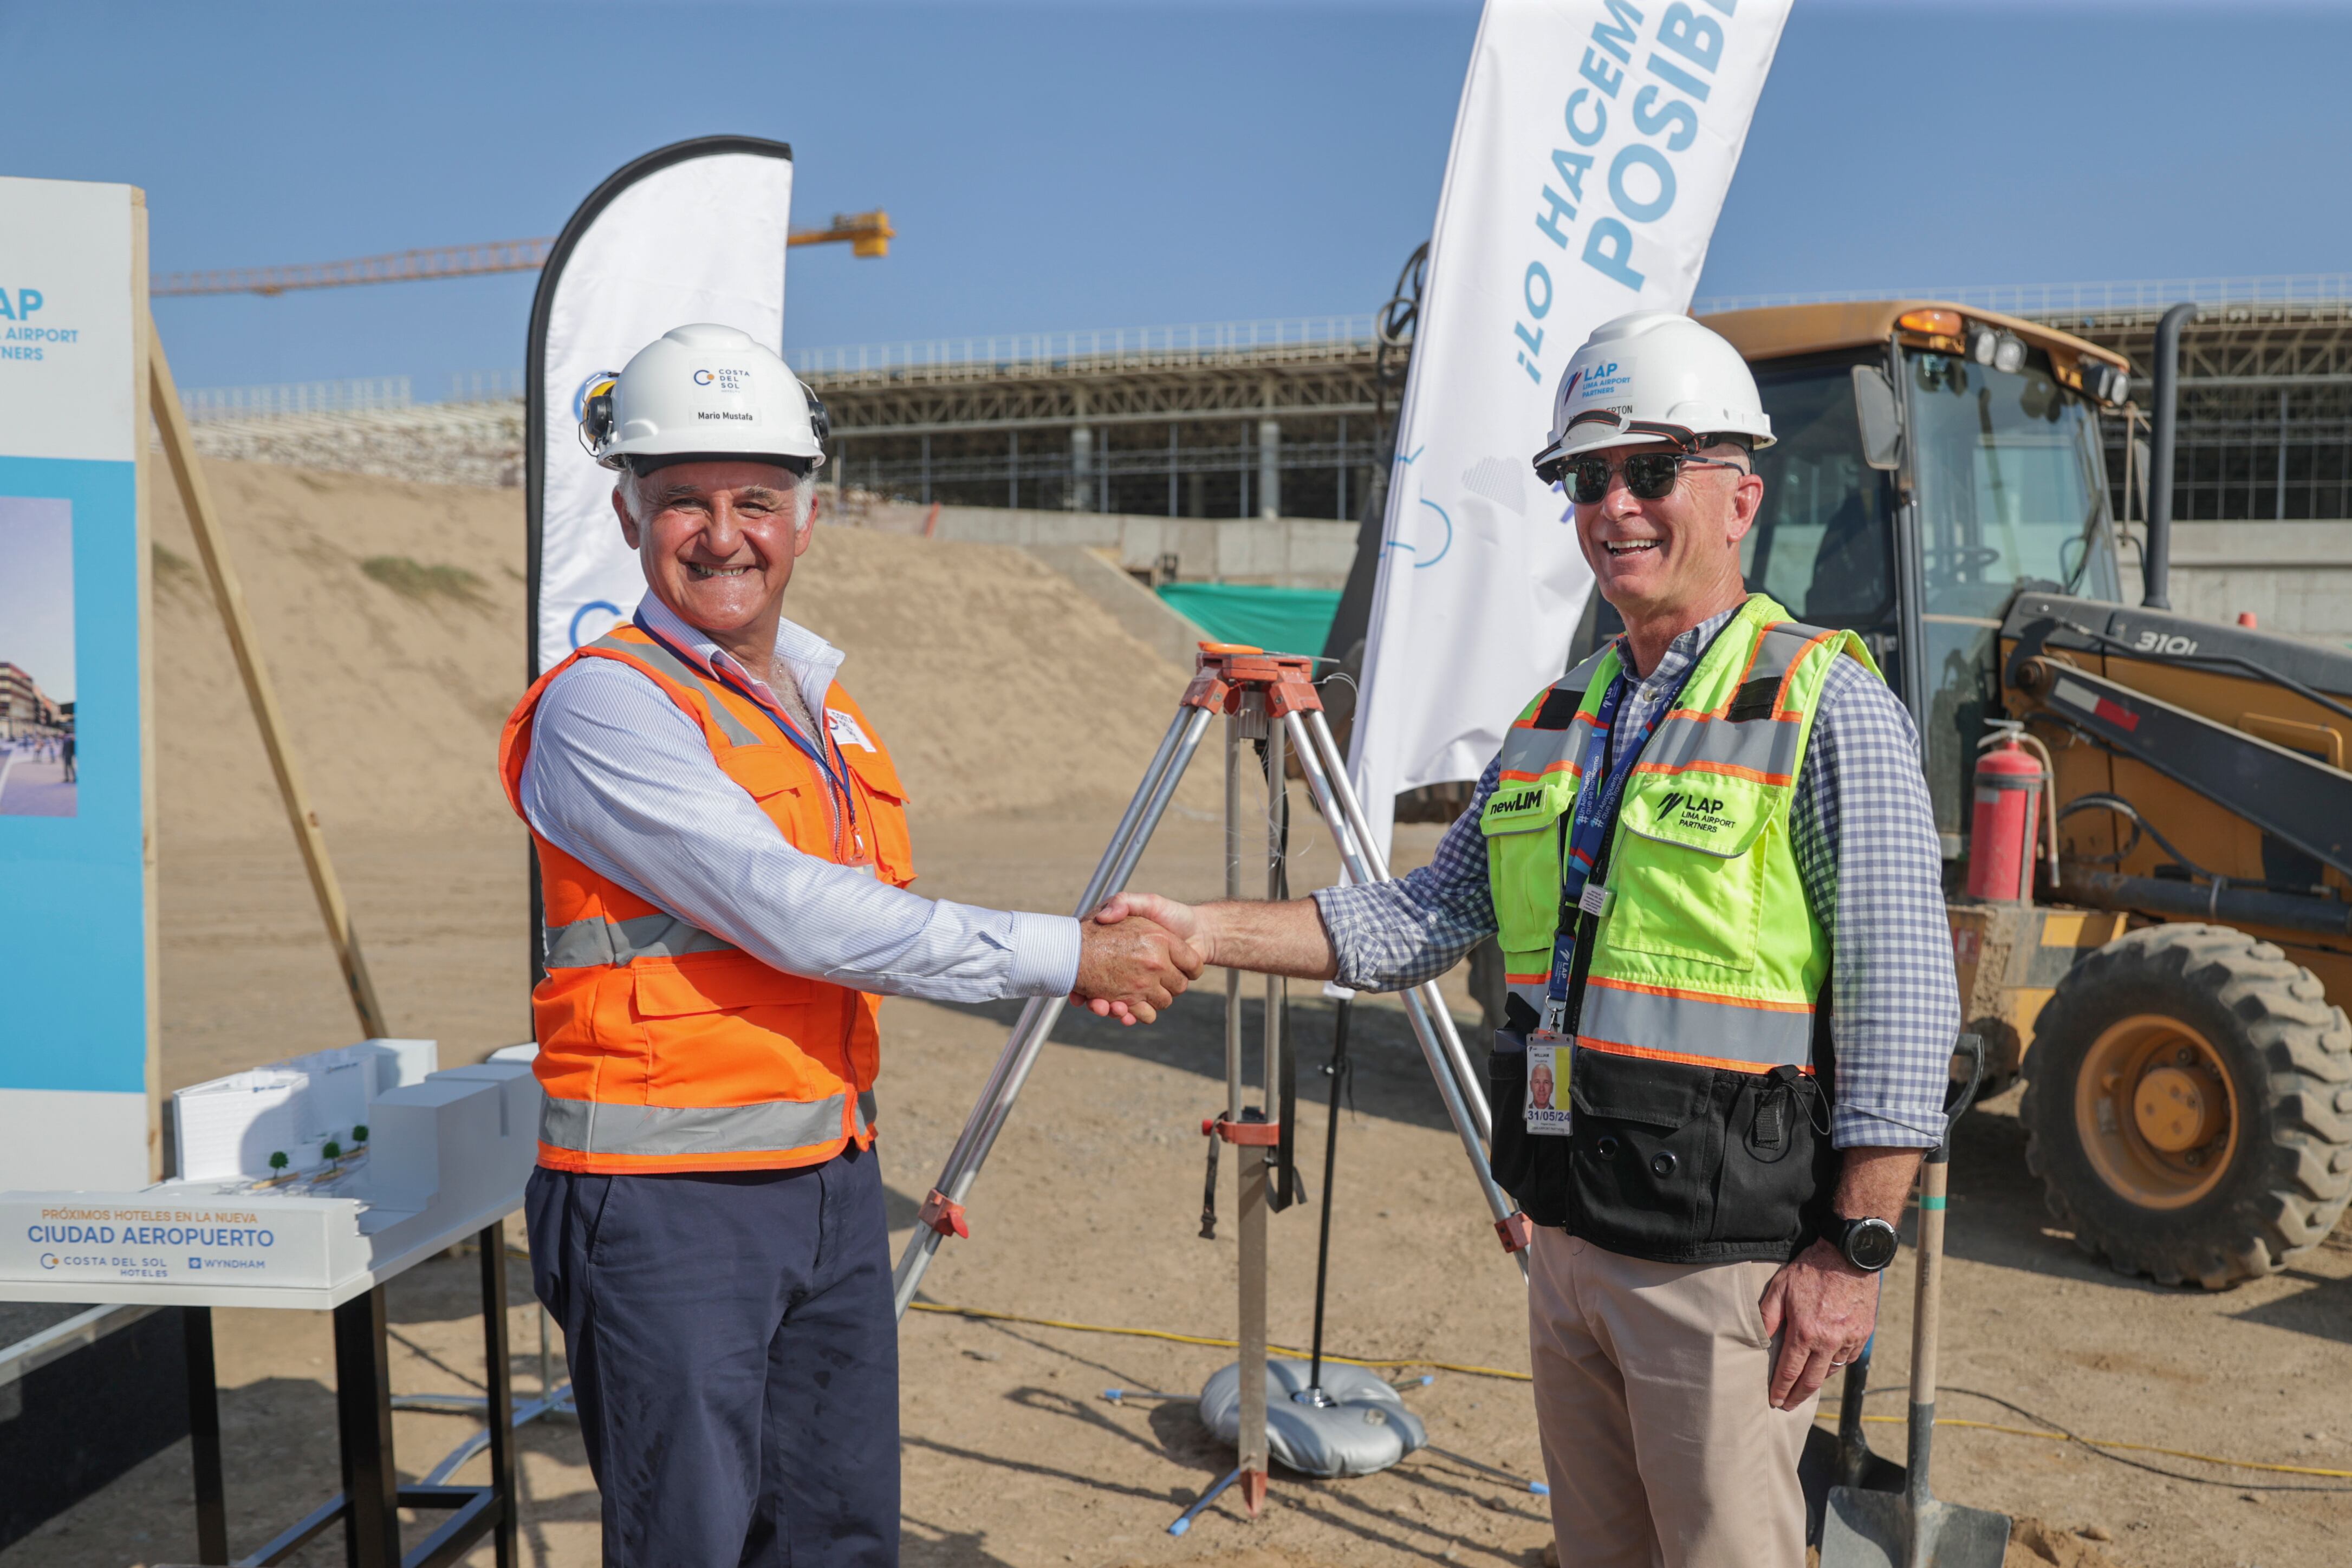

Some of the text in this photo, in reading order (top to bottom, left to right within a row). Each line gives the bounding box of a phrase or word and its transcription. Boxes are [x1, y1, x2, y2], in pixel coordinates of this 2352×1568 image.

[1581, 0, 1737, 292] POSIB
[5, 327, 79, 343] AIRPORT
[719, 369, 750, 377] COSTA
[1584, 362, 1617, 382] LAP
[1582, 377, 1630, 390] LIMA AIRPORT
[1582, 387, 1615, 399] PARTNERS
[698, 412, 753, 421] Mario Mustafa
[1490, 790, 1543, 815] newLIM
[1685, 794, 1724, 815] LAP
[1679, 819, 1718, 833] PARTNERS
[1681, 811, 1736, 829] LIMA AIRPORT
[1528, 1110, 1571, 1122] 31/05/24
[42, 1207, 258, 1224] PRÓXIMOS HOTELES EN LA NUEVA
[28, 1225, 274, 1247] CIUDAD AEROPUERTO
[63, 1257, 265, 1268] COSTA DEL SOL WYNDHAM
[120, 1269, 168, 1278] HOTELES
